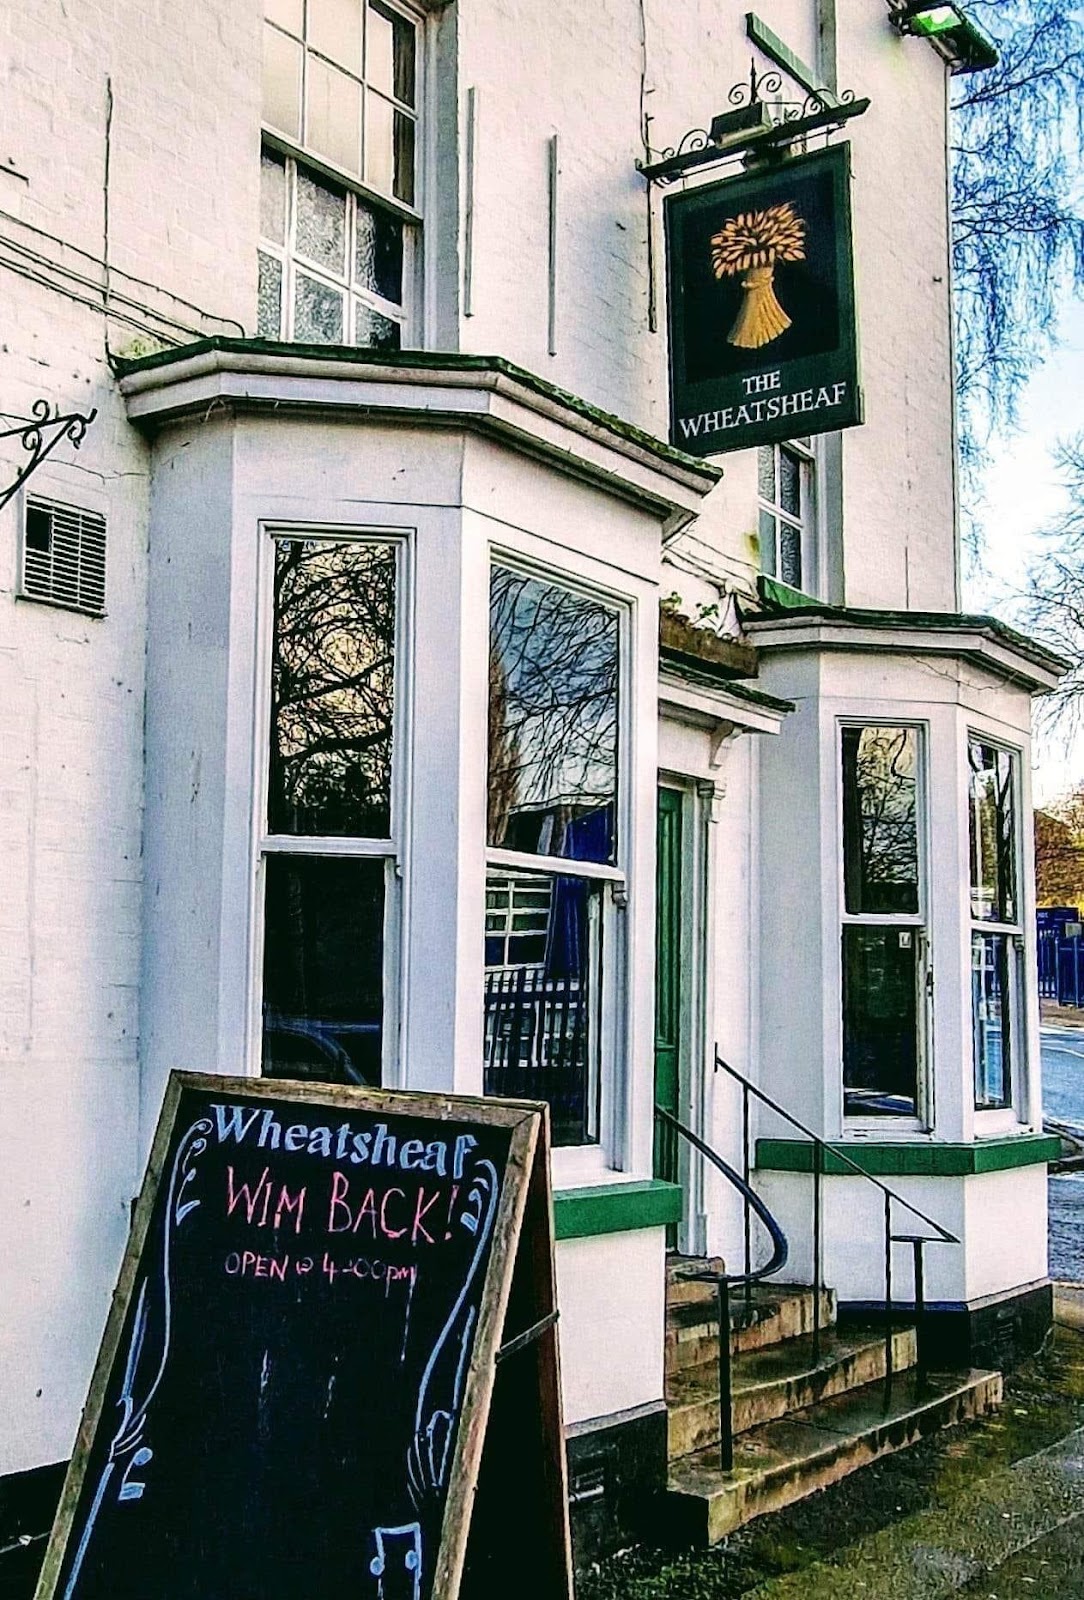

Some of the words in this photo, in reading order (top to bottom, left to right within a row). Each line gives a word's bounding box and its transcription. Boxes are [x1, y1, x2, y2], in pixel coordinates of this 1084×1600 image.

[742, 370, 781, 395] THE
[678, 382, 847, 439] WHEATSHEAF
[209, 1104, 478, 1180] Wheatsheaf
[225, 1251, 289, 1282] OPEN
